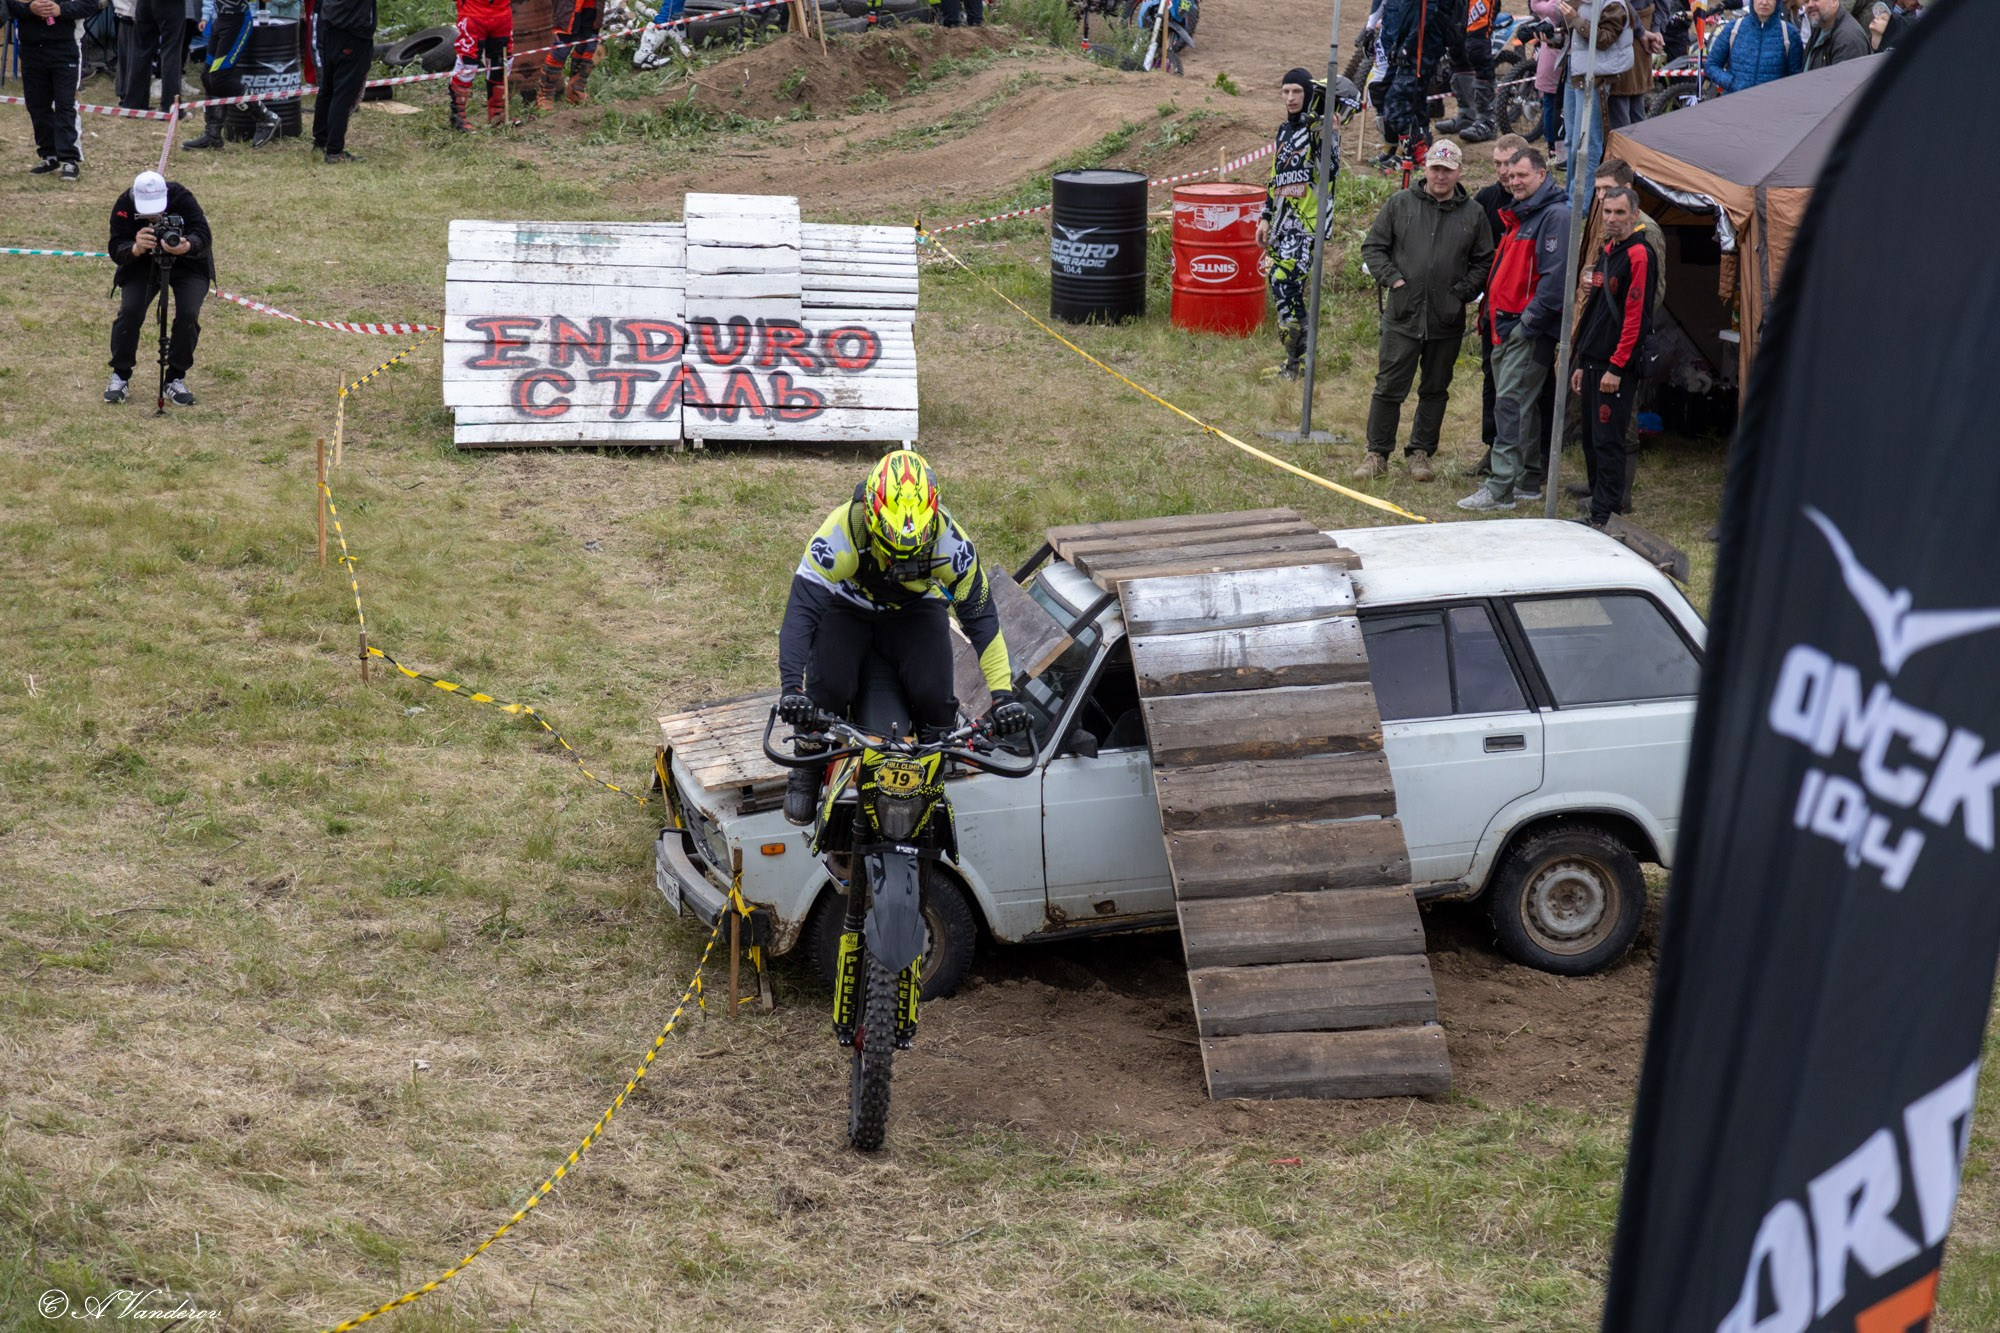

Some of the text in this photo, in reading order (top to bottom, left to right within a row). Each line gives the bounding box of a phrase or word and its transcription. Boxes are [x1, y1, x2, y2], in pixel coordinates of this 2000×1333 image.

[1052, 237, 1119, 258] ECORD
[1071, 257, 1107, 268] RADIO
[1191, 263, 1237, 274] SINTEC
[465, 315, 882, 373] ENDURO
[510, 364, 826, 422] СТАЛЬ
[891, 771, 910, 787] 19
[841, 955, 858, 1024] PIRELLI
[898, 970, 909, 1030] IRELLI
